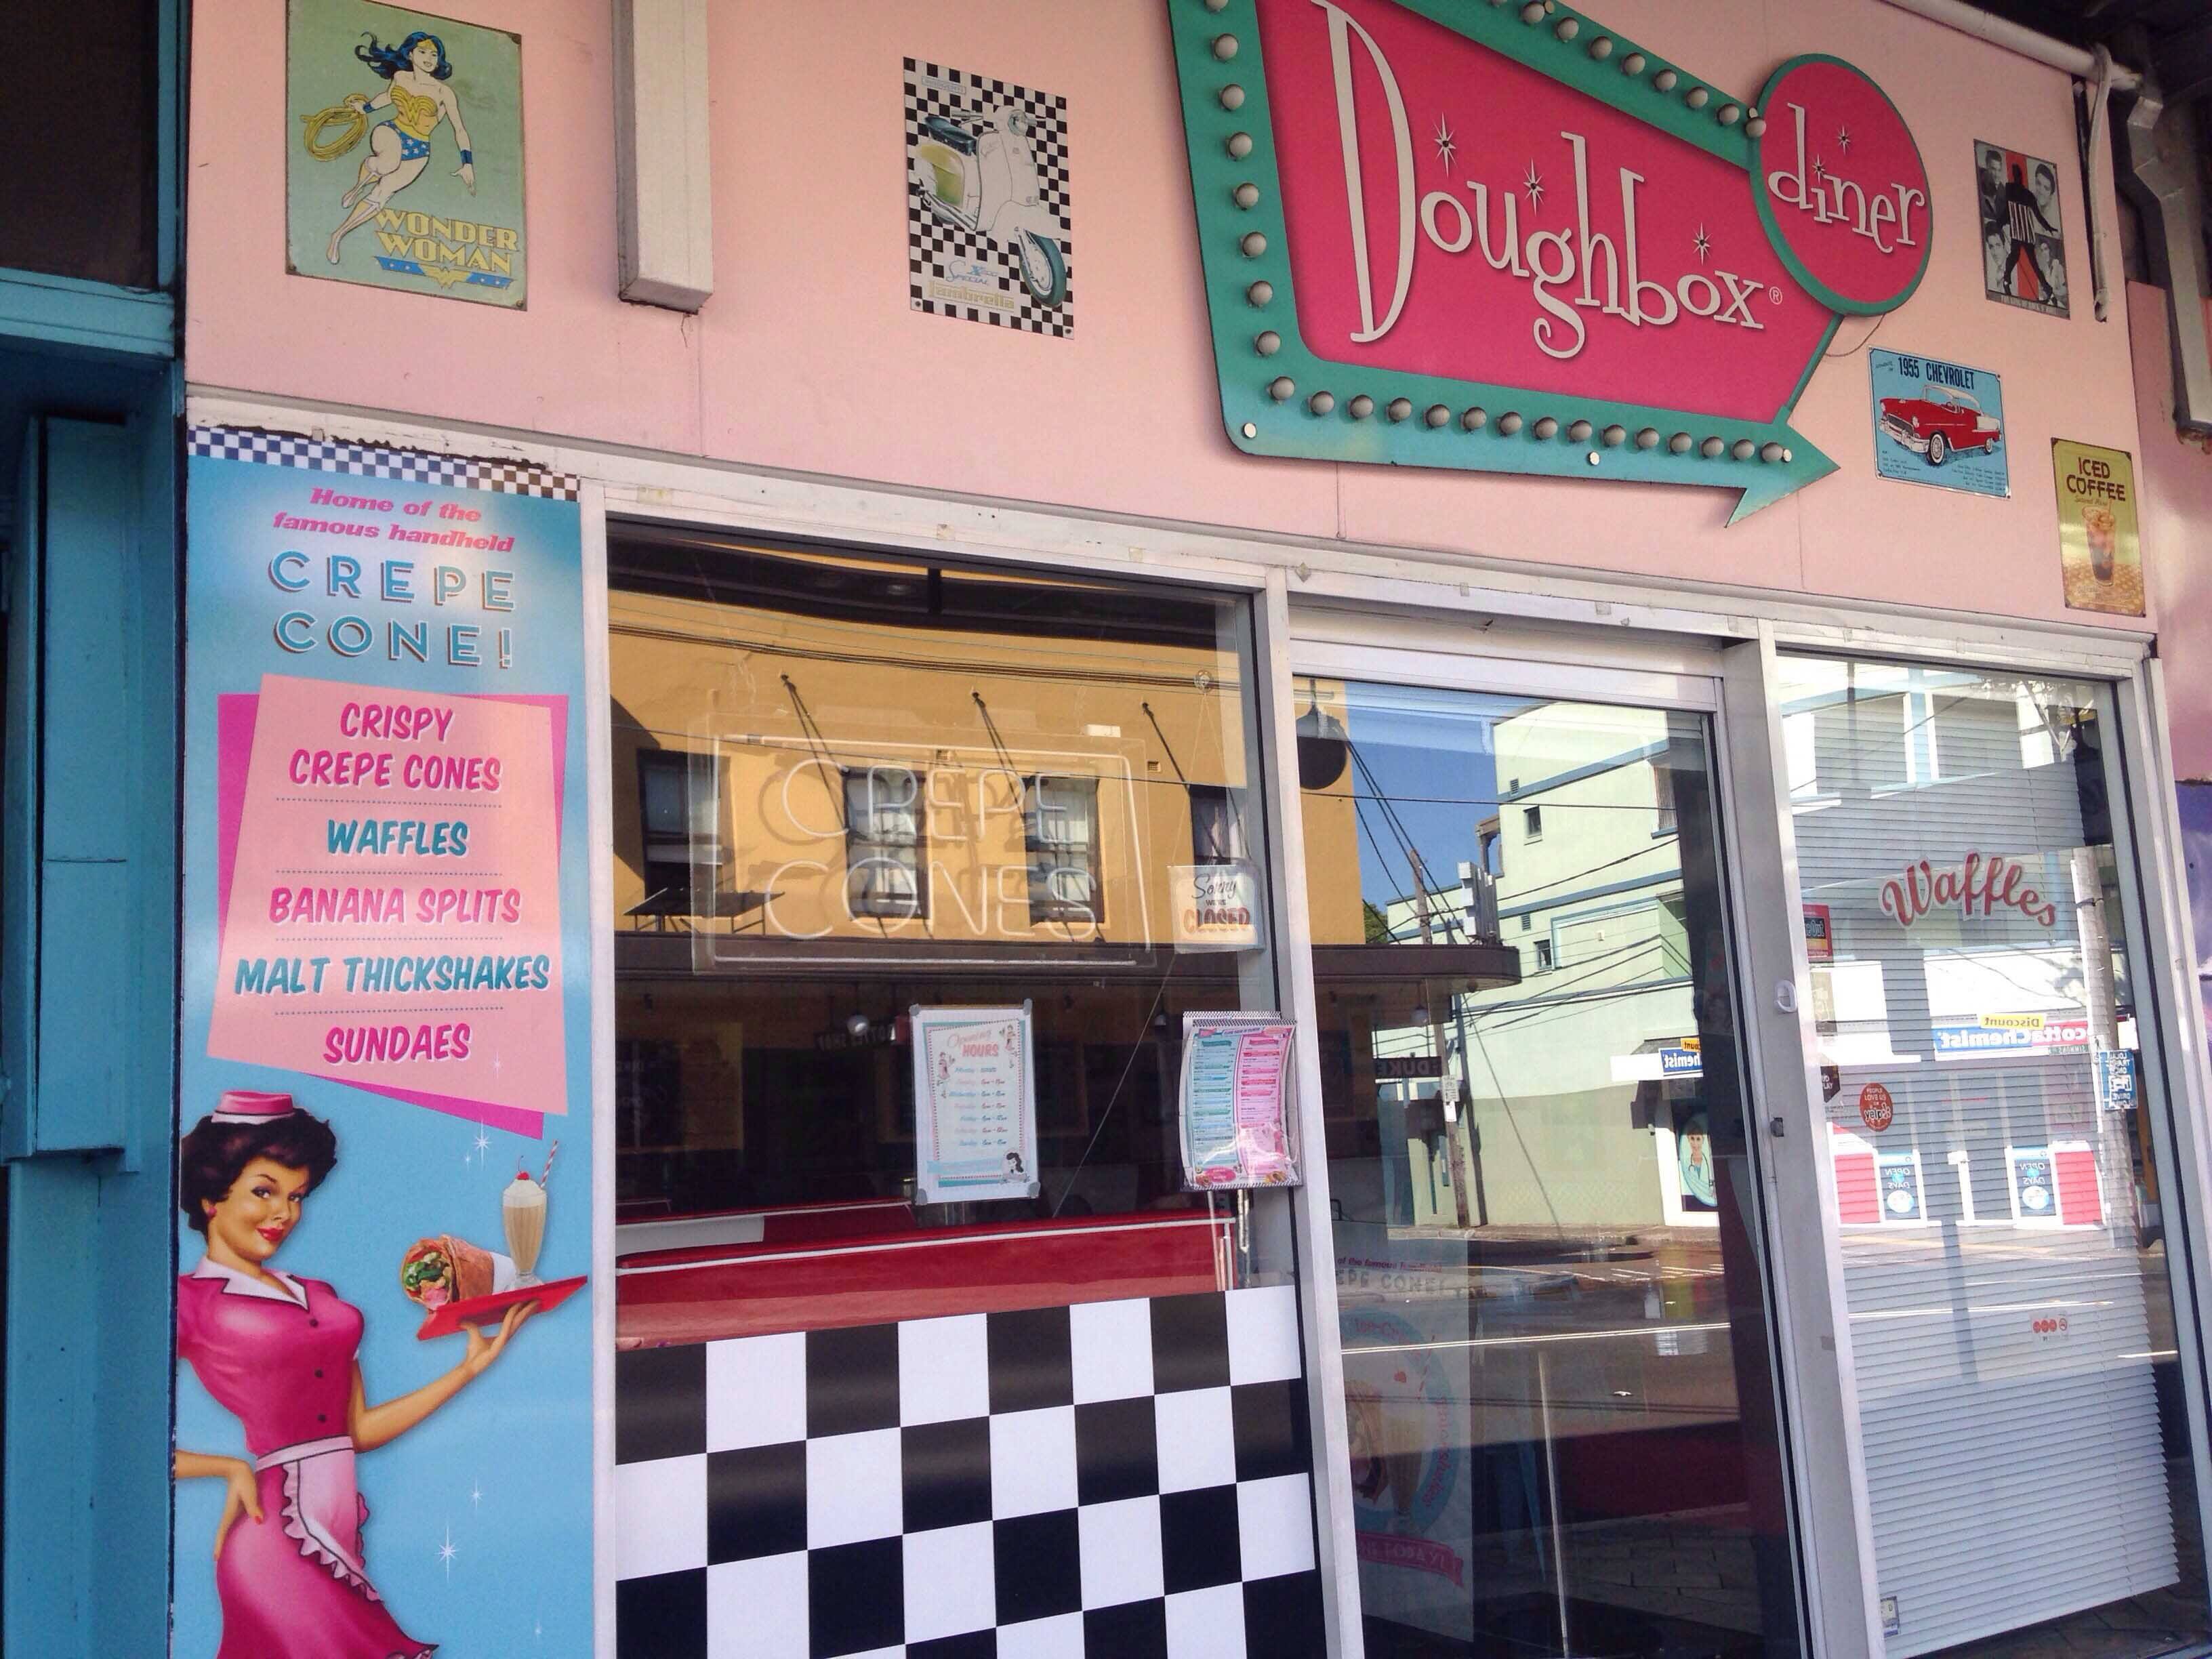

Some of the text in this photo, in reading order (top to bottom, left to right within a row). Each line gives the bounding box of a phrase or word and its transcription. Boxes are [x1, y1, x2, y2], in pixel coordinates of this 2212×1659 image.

[1311, 0, 1764, 359] Doughbox
[1767, 102, 1925, 254] diner
[374, 208, 519, 251] WONDER
[375, 230, 511, 274] WOMAN
[1898, 356, 1919, 379] 1955
[1926, 363, 1975, 390] CHEVROLET
[2066, 474, 2126, 501] COFFEE
[2078, 457, 2110, 479] ICED
[310, 487, 483, 523] Home of the
[272, 511, 516, 553] famous handheld
[268, 550, 515, 612] CREPE
[273, 610, 514, 670] CONE!
[340, 702, 454, 742] CRISPY
[289, 749, 502, 792] CREPE CONES
[782, 757, 1075, 844] CREPE
[327, 819, 470, 857] WAFFLES
[268, 887, 522, 926] BANANA SPLITS
[765, 857, 1098, 940] CONES
[1191, 874, 1237, 899] Sorry
[1881, 852, 2056, 926] Waffles
[1183, 907, 1250, 933] CLOSED
[234, 954, 551, 996] MALT THICKSHAKES
[323, 1023, 473, 1065] SUNDAES
[962, 1044, 1000, 1058] HOURS
[1864, 1109, 1883, 1122] yelp
